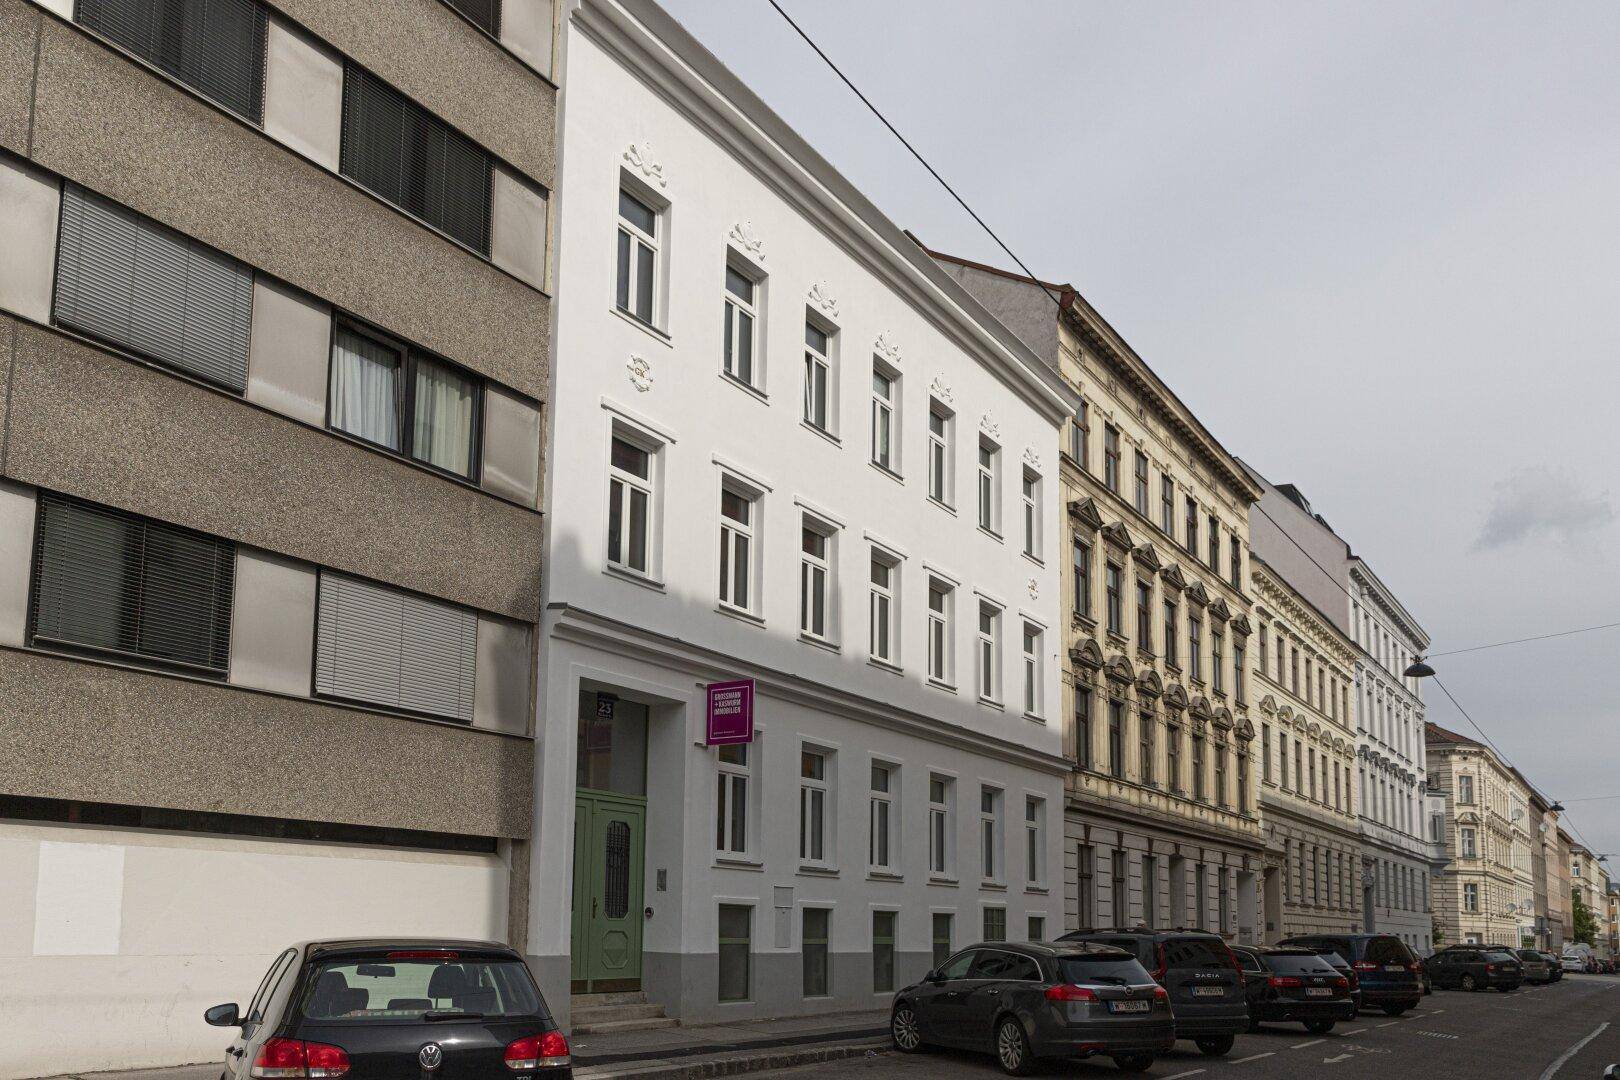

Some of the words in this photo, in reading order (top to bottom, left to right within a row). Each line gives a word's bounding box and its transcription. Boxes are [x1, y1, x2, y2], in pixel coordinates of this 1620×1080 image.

[714, 691, 741, 701] GROSSMANN
[599, 701, 611, 713] 23
[713, 706, 741, 715] IMMOBILIEN
